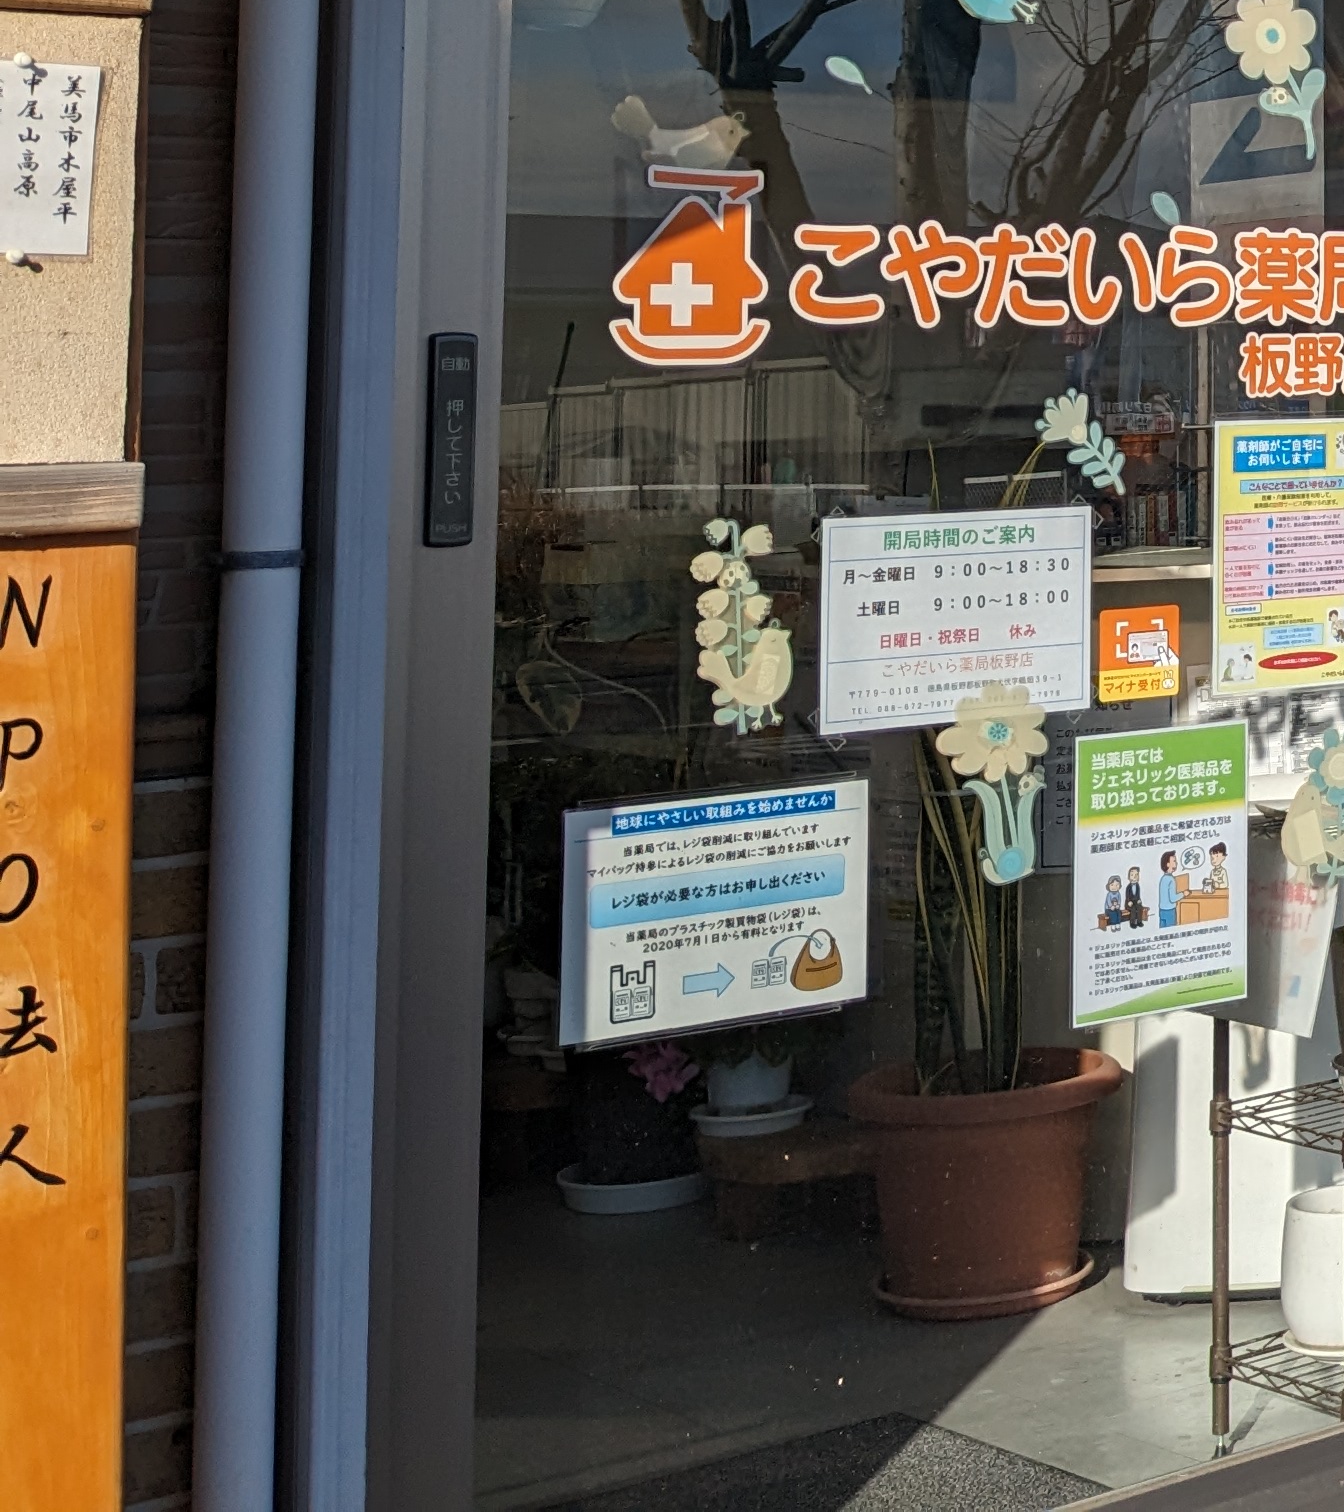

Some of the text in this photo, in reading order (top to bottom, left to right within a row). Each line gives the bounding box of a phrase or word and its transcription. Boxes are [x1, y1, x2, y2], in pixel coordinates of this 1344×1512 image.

[13, 74, 43, 197] 中尾山高原
[52, 75, 86, 224] 美馬市木屋平
[441, 356, 470, 371] 自動
[444, 399, 464, 504] 押して下さい
[1236, 439, 1324, 454] 薬剤師がご自宅に
[1247, 453, 1312, 467] お伺いします
[435, 522, 467, 533] PUSH
[883, 524, 1035, 551] 開局時間のご案内
[843, 566, 916, 585] 月～金曜日
[857, 600, 900, 617] 土曜日
[880, 624, 1036, 650] 日曜日・祝祭日 休み
[882, 651, 1034, 678] こやだいら薬局板野店
[1103, 678, 1161, 694] マイナ受付
[1091, 747, 1163, 770] 当薬局では
[1092, 759, 1232, 789] ジェネリック医薬品を
[1091, 780, 1225, 810] 取り扱っております。
[615, 794, 833, 830] 地球にやさしい取組みを始めませんか
[623, 824, 819, 857] 当薬局では、レジ袋削減に取り組んでいます
[1091, 816, 1231, 841] ジェネリック医薬品をご希望される方は
[587, 837, 852, 878] マイバッグ持参によるレジ袋の削減にご協力をお願いします
[611, 870, 826, 910] レジ袋が必要な方はお申し出ください
[642, 921, 805, 954] 2020年7月1日から有料となります
